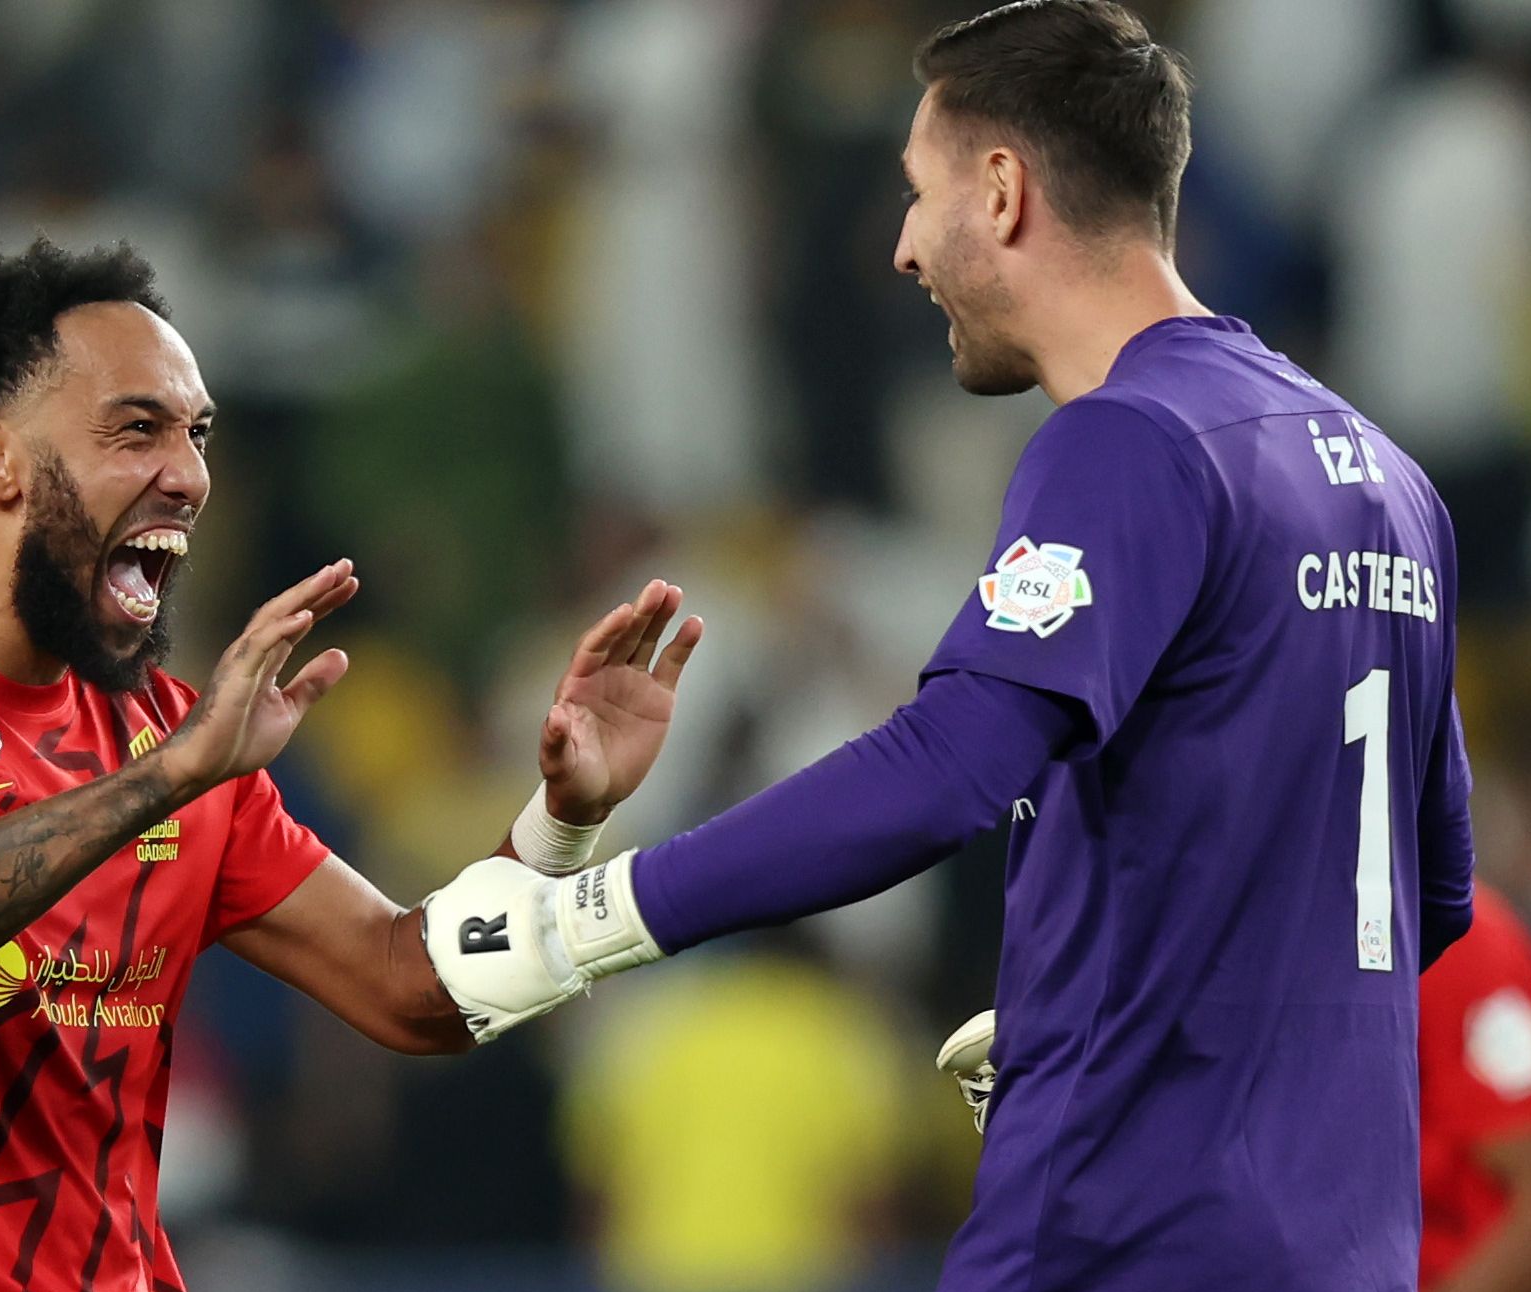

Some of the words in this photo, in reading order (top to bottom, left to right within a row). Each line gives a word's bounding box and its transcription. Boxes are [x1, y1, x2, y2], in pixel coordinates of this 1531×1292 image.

[1016, 579, 1053, 600] RSL
[1297, 551, 1438, 623] CASTEELS
[1344, 668, 1393, 971] 1
[576, 872, 589, 910] KOEN
[592, 863, 608, 920] CASTEE
[459, 911, 511, 955] R
[30, 990, 90, 1028] Aoula
[93, 994, 166, 1028] Aviation
